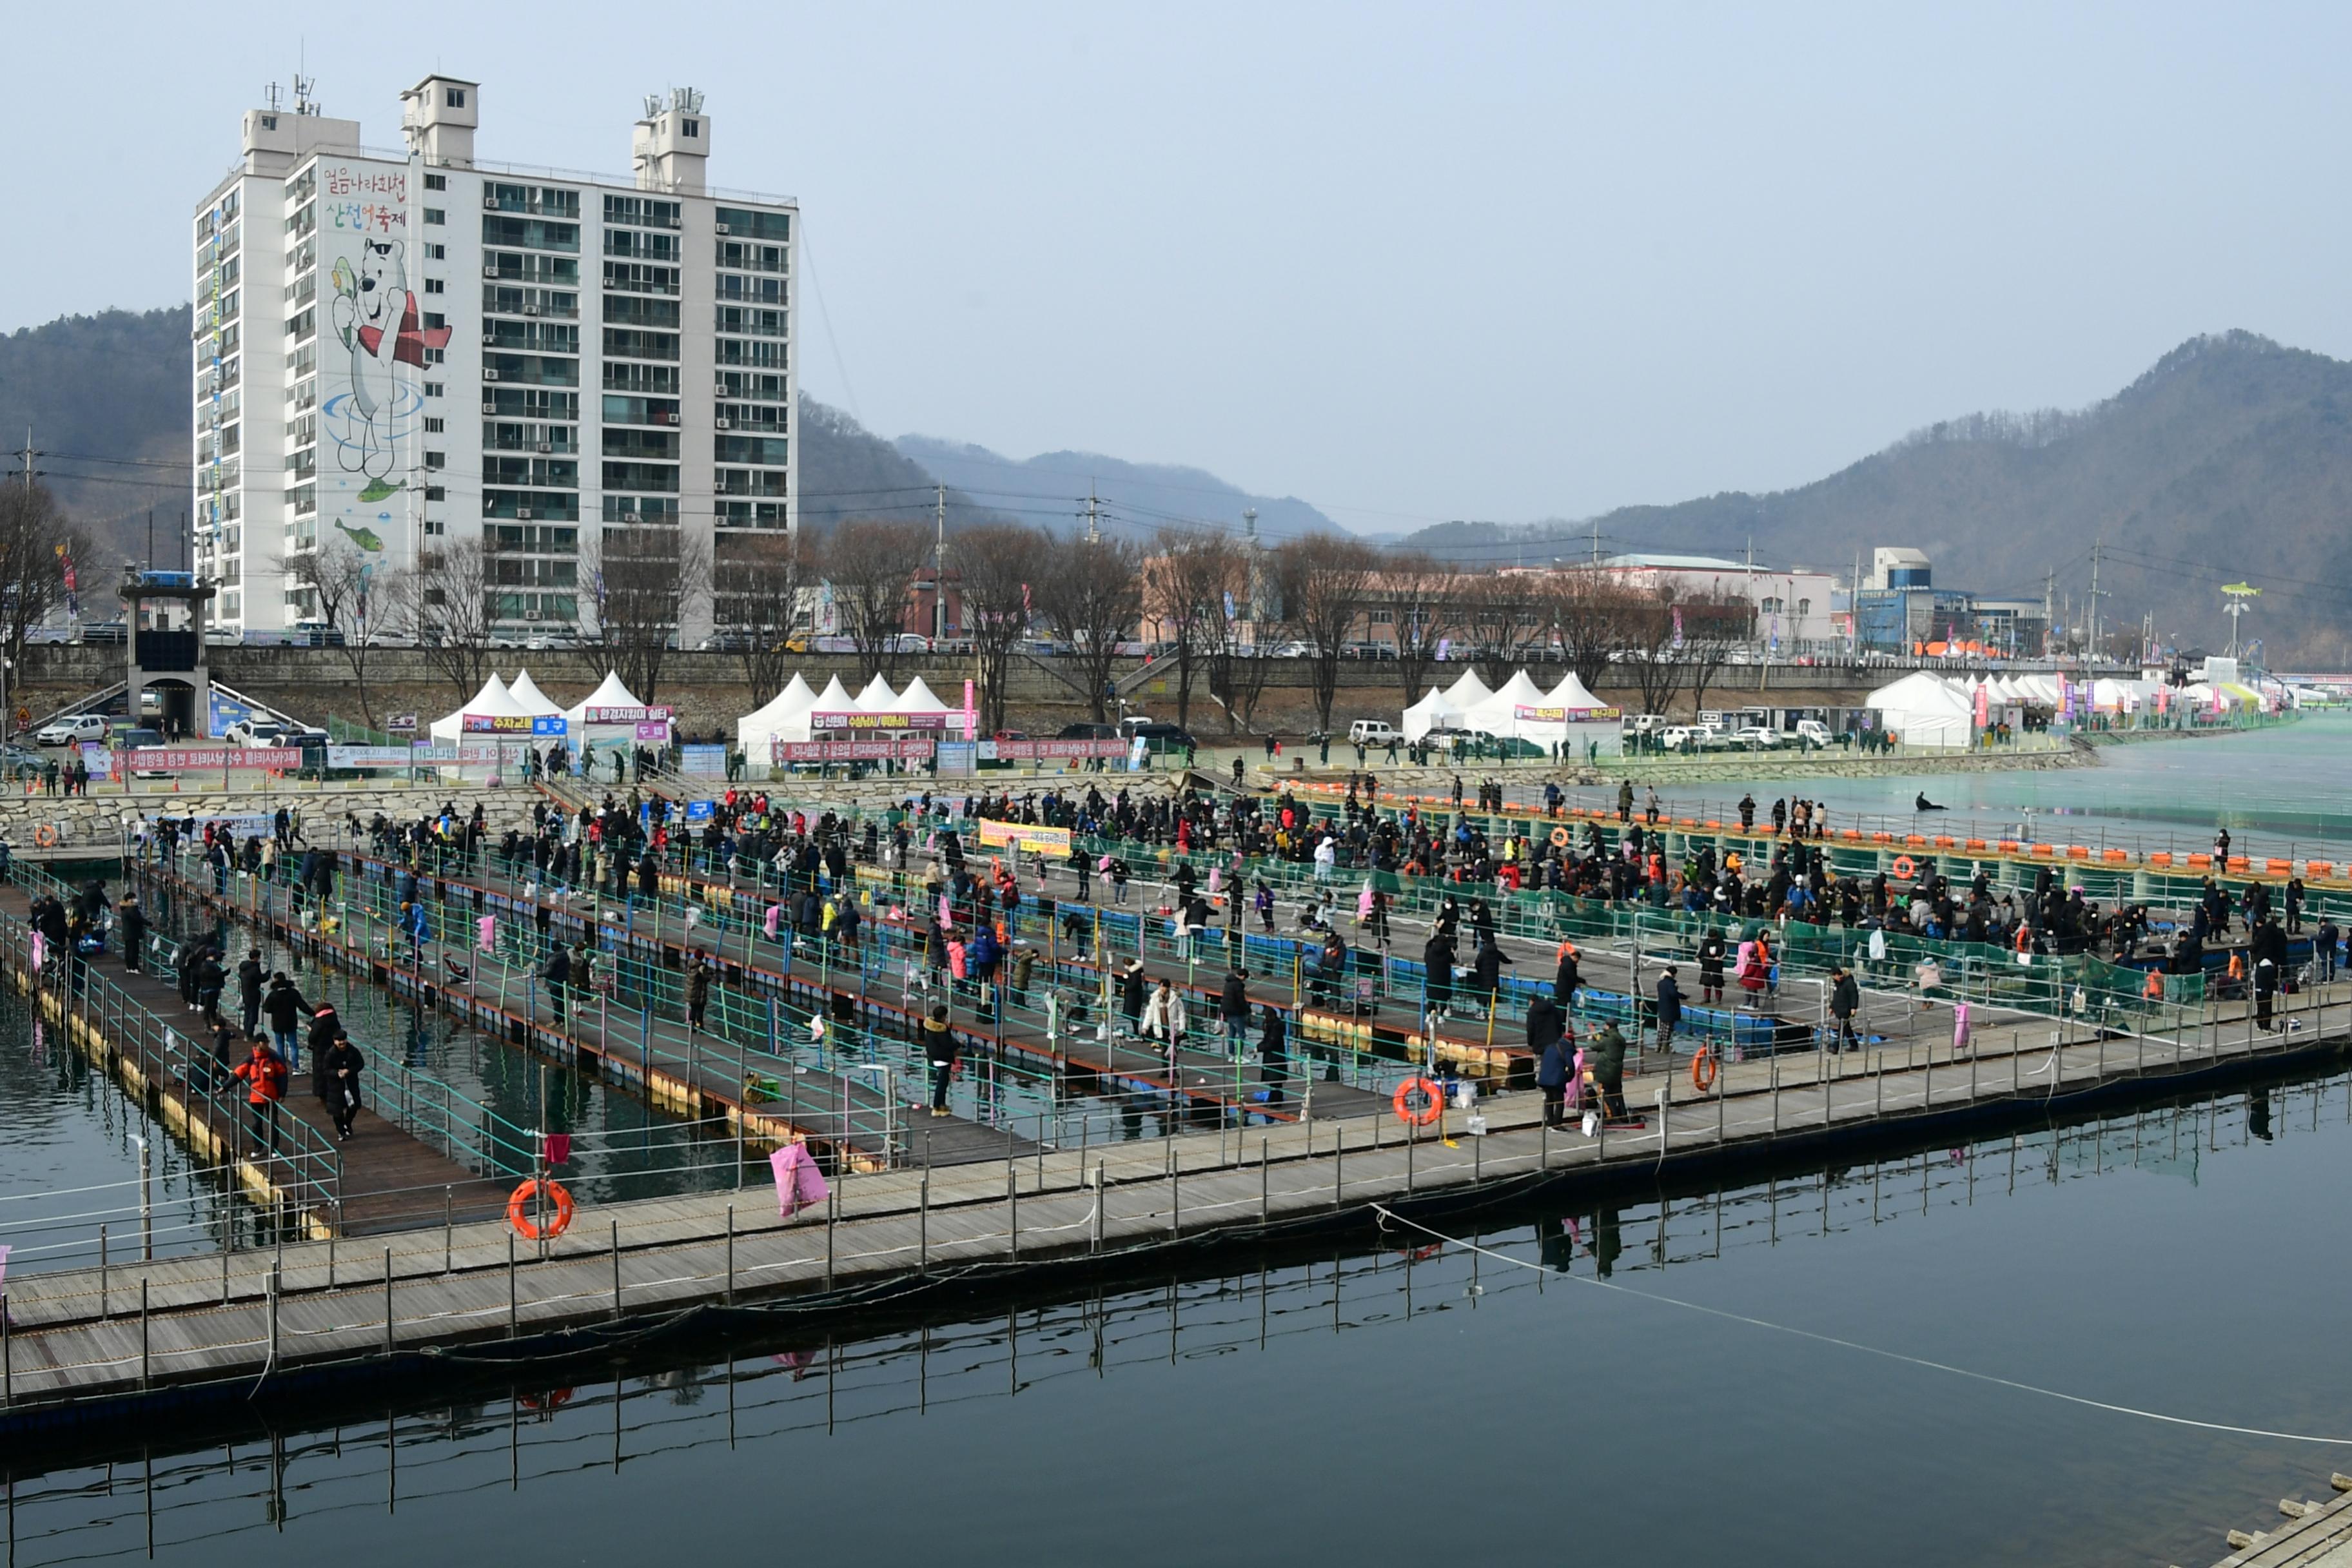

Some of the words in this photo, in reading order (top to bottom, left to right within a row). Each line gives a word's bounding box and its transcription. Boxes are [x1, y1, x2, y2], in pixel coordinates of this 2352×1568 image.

[326, 202, 406, 233] 산천어축제
[600, 708, 646, 720] 환경지킴이
[649, 708, 667, 720] 쉼터
